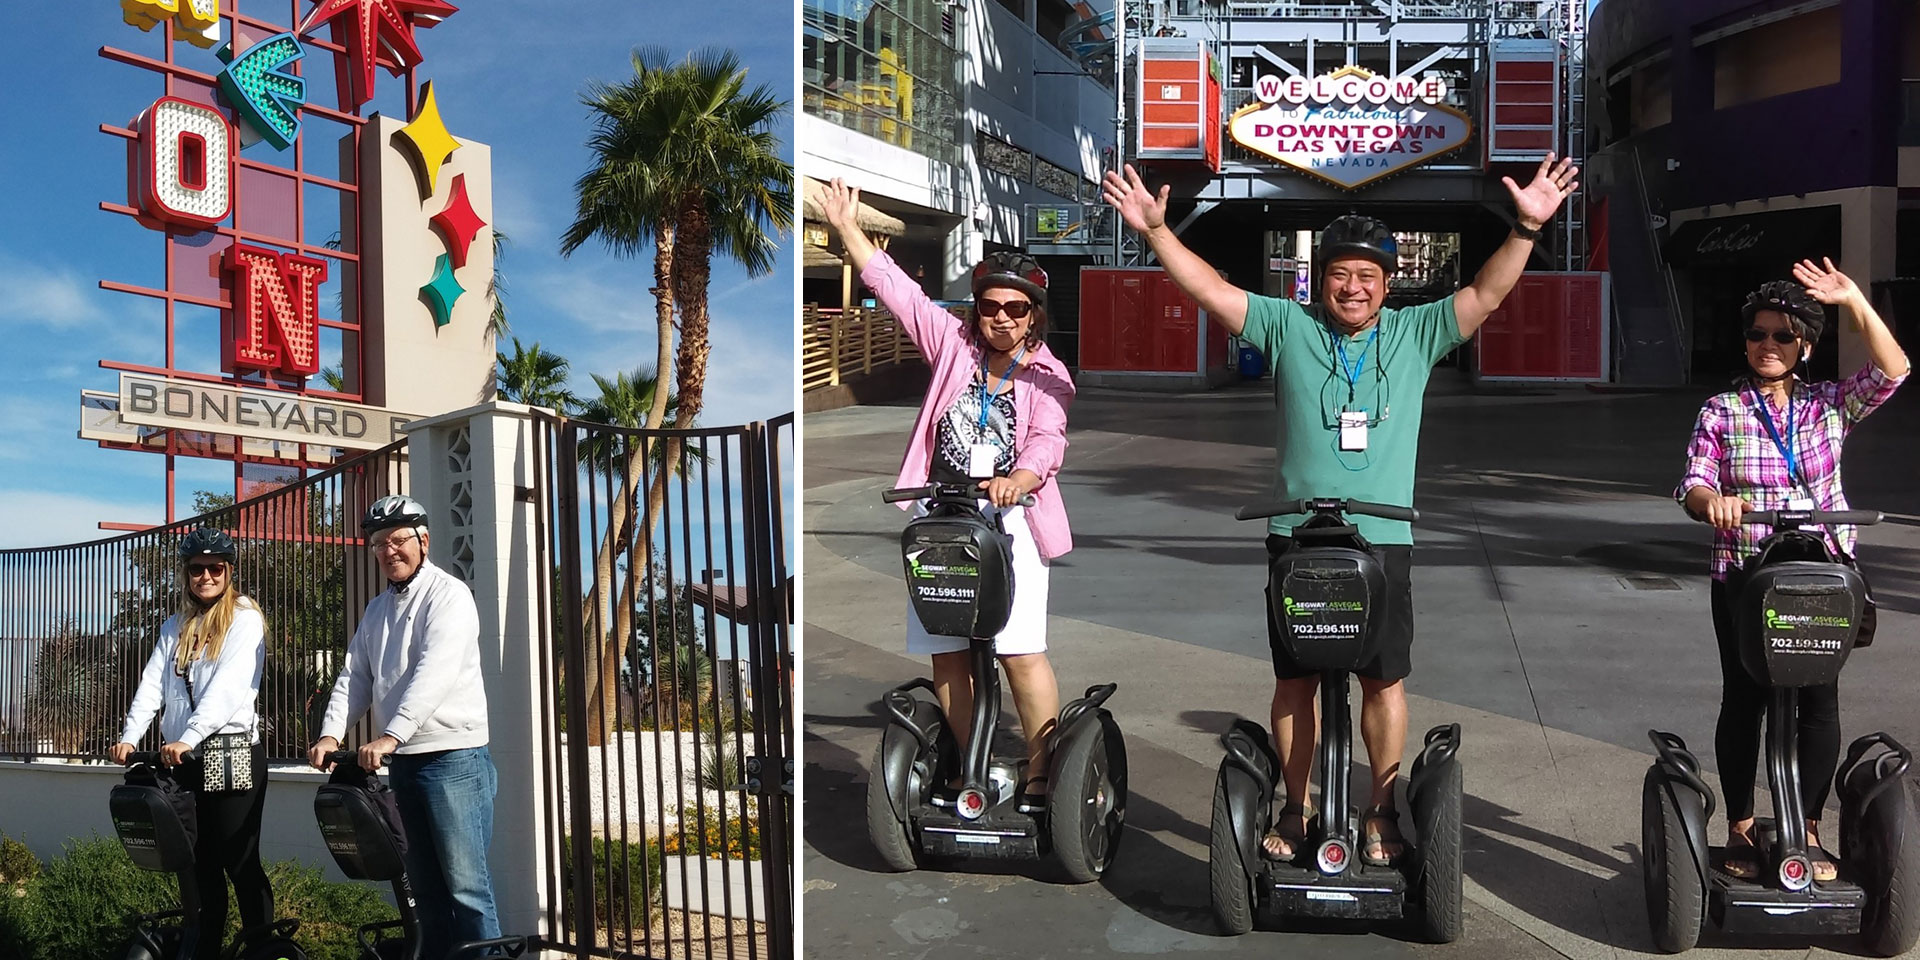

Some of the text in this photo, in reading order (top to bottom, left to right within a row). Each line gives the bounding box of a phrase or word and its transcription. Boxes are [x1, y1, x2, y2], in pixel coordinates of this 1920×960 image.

[1259, 80, 1440, 98] WELCOME
[1282, 109, 1299, 119] TO
[1303, 104, 1408, 123] Fabulous
[1254, 124, 1446, 139] DOWNTOWN
[1277, 139, 1424, 154] LAS VEGAS
[1311, 157, 1390, 168] NEVADA
[129, 382, 369, 439] BONEYARD
[917, 586, 975, 597] 702.596.1111
[1292, 624, 1359, 633] 702.596.1111
